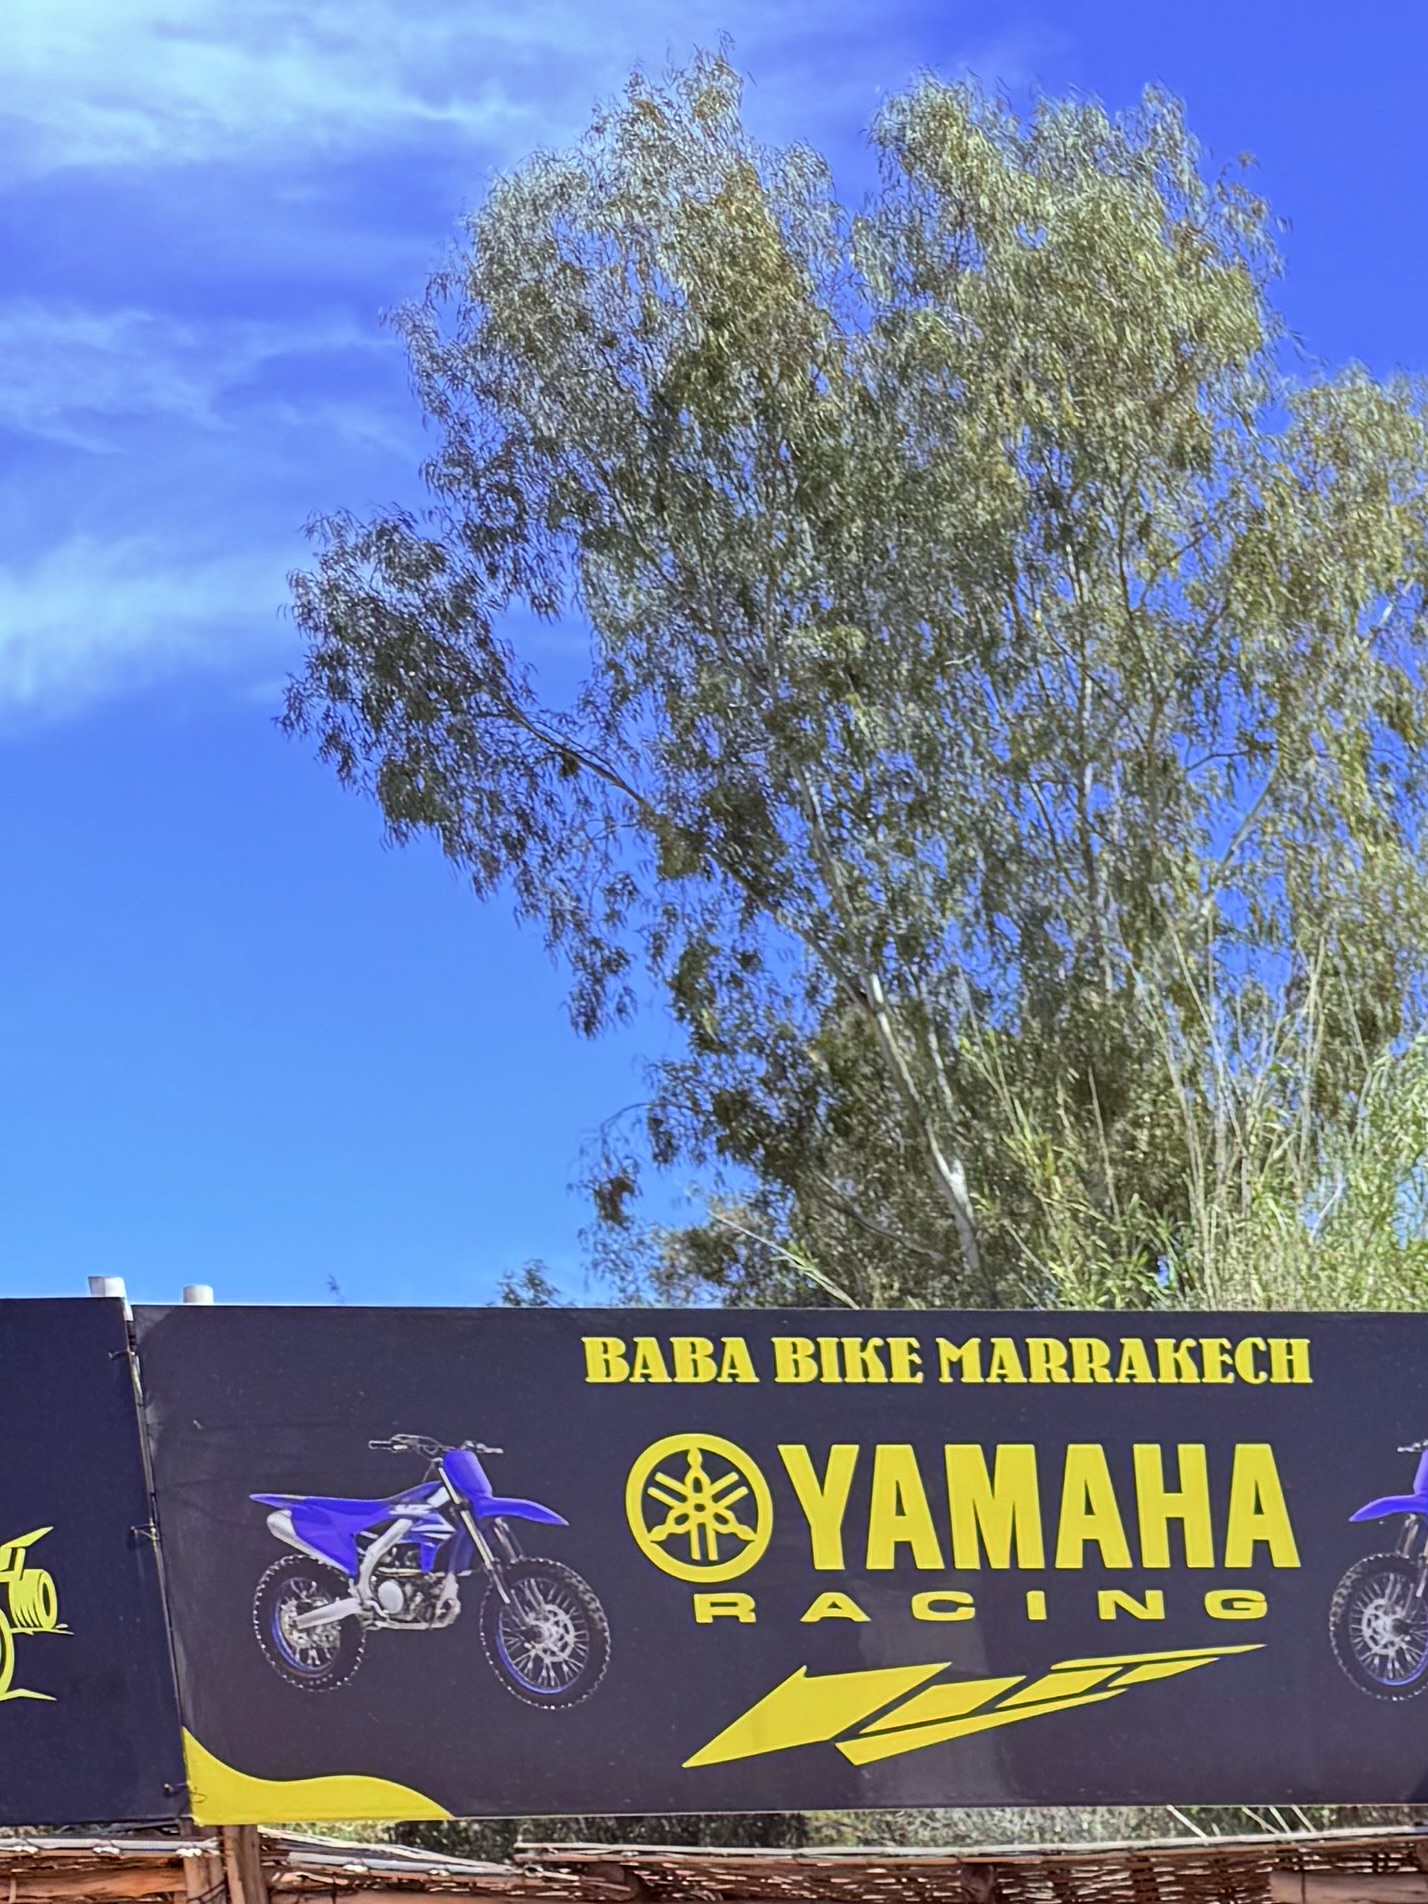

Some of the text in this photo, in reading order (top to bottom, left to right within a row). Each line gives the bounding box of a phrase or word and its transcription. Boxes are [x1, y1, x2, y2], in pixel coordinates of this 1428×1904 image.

[582, 1337, 1314, 1385] BABA BIKE MARRAKECH
[778, 1443, 1301, 1571] YAMAHA
[694, 1589, 1269, 1624] RACING
